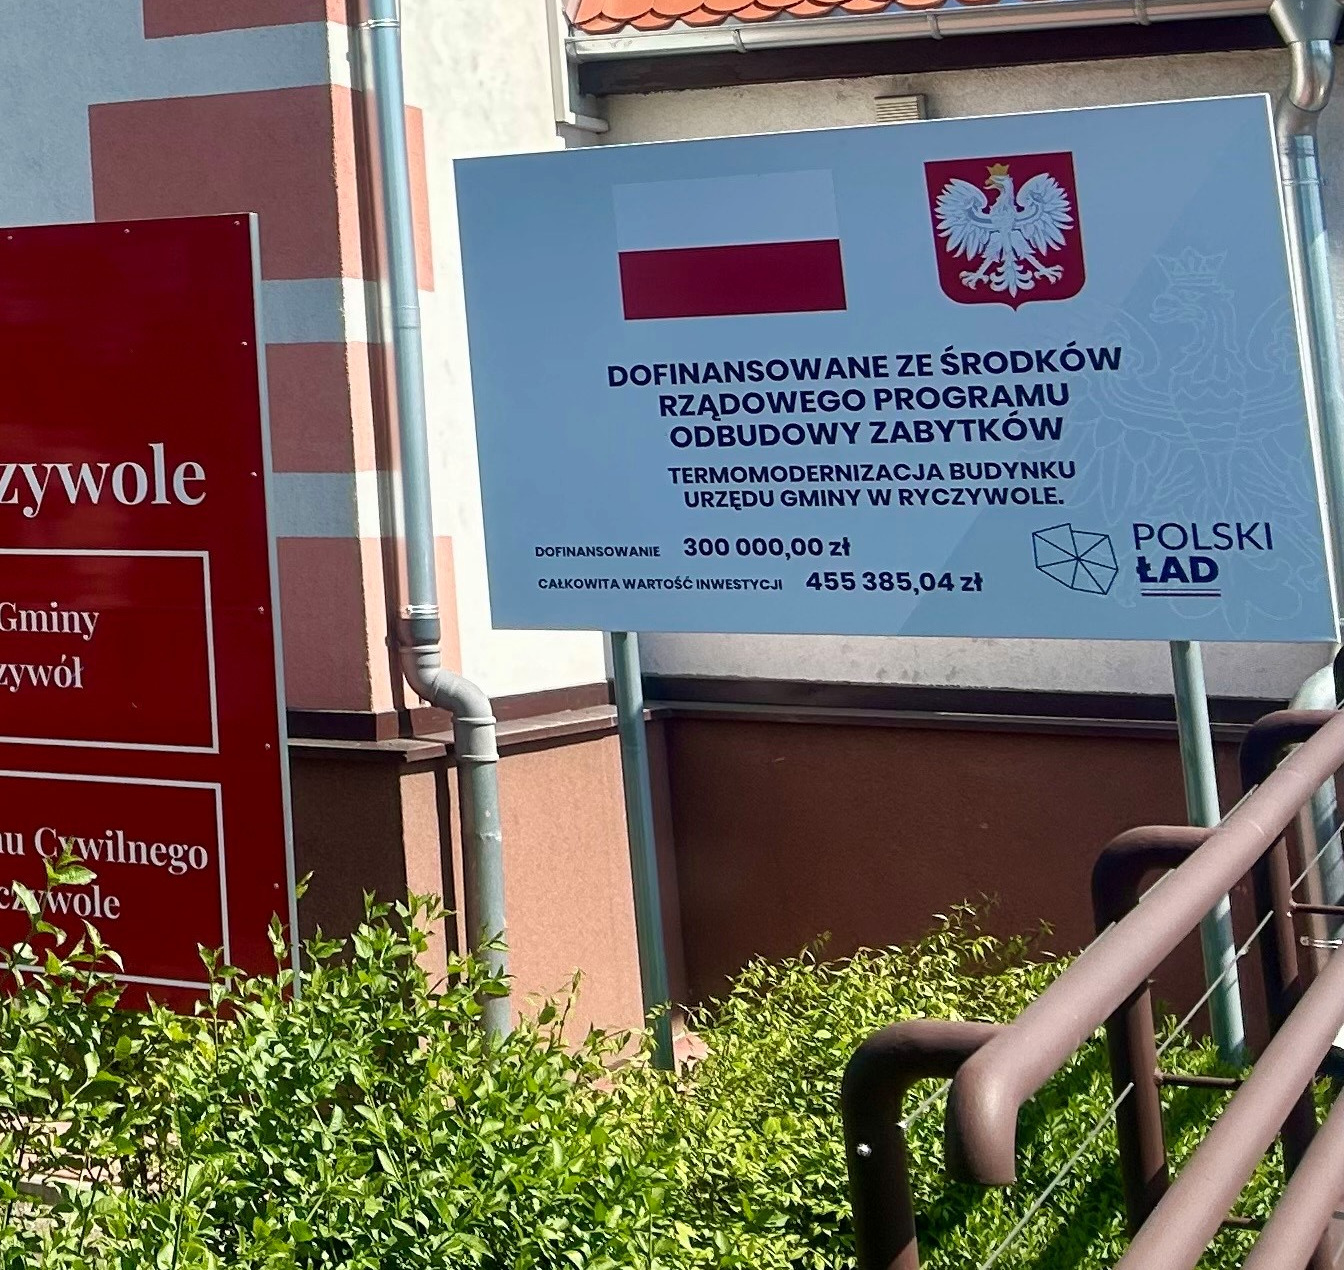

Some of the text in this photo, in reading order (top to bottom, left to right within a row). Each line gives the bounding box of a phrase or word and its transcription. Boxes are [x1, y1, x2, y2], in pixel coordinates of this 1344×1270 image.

[608, 341, 1121, 387] DOFINANSOWANE ZE ŚRODKÓW
[659, 383, 1069, 421] RZĄDOWEGO PROGRAMU
[670, 410, 1063, 448] ODBUDOWY ZABYTKÓW
[668, 461, 1075, 484] TERMOMODERNIZACJA BUDYNKU
[684, 487, 1064, 510] URZĘDU GMINY W RYCZYWOLE.
[535, 537, 850, 560] DOFINANSOWANIE 300 000,00 zł
[1133, 522, 1272, 550] POLSKI
[1136, 556, 1218, 583] ŁAD
[538, 572, 983, 595] CAŁKOWITA WARTOŚĆ INWESTYCJI 455 385,04 zł
